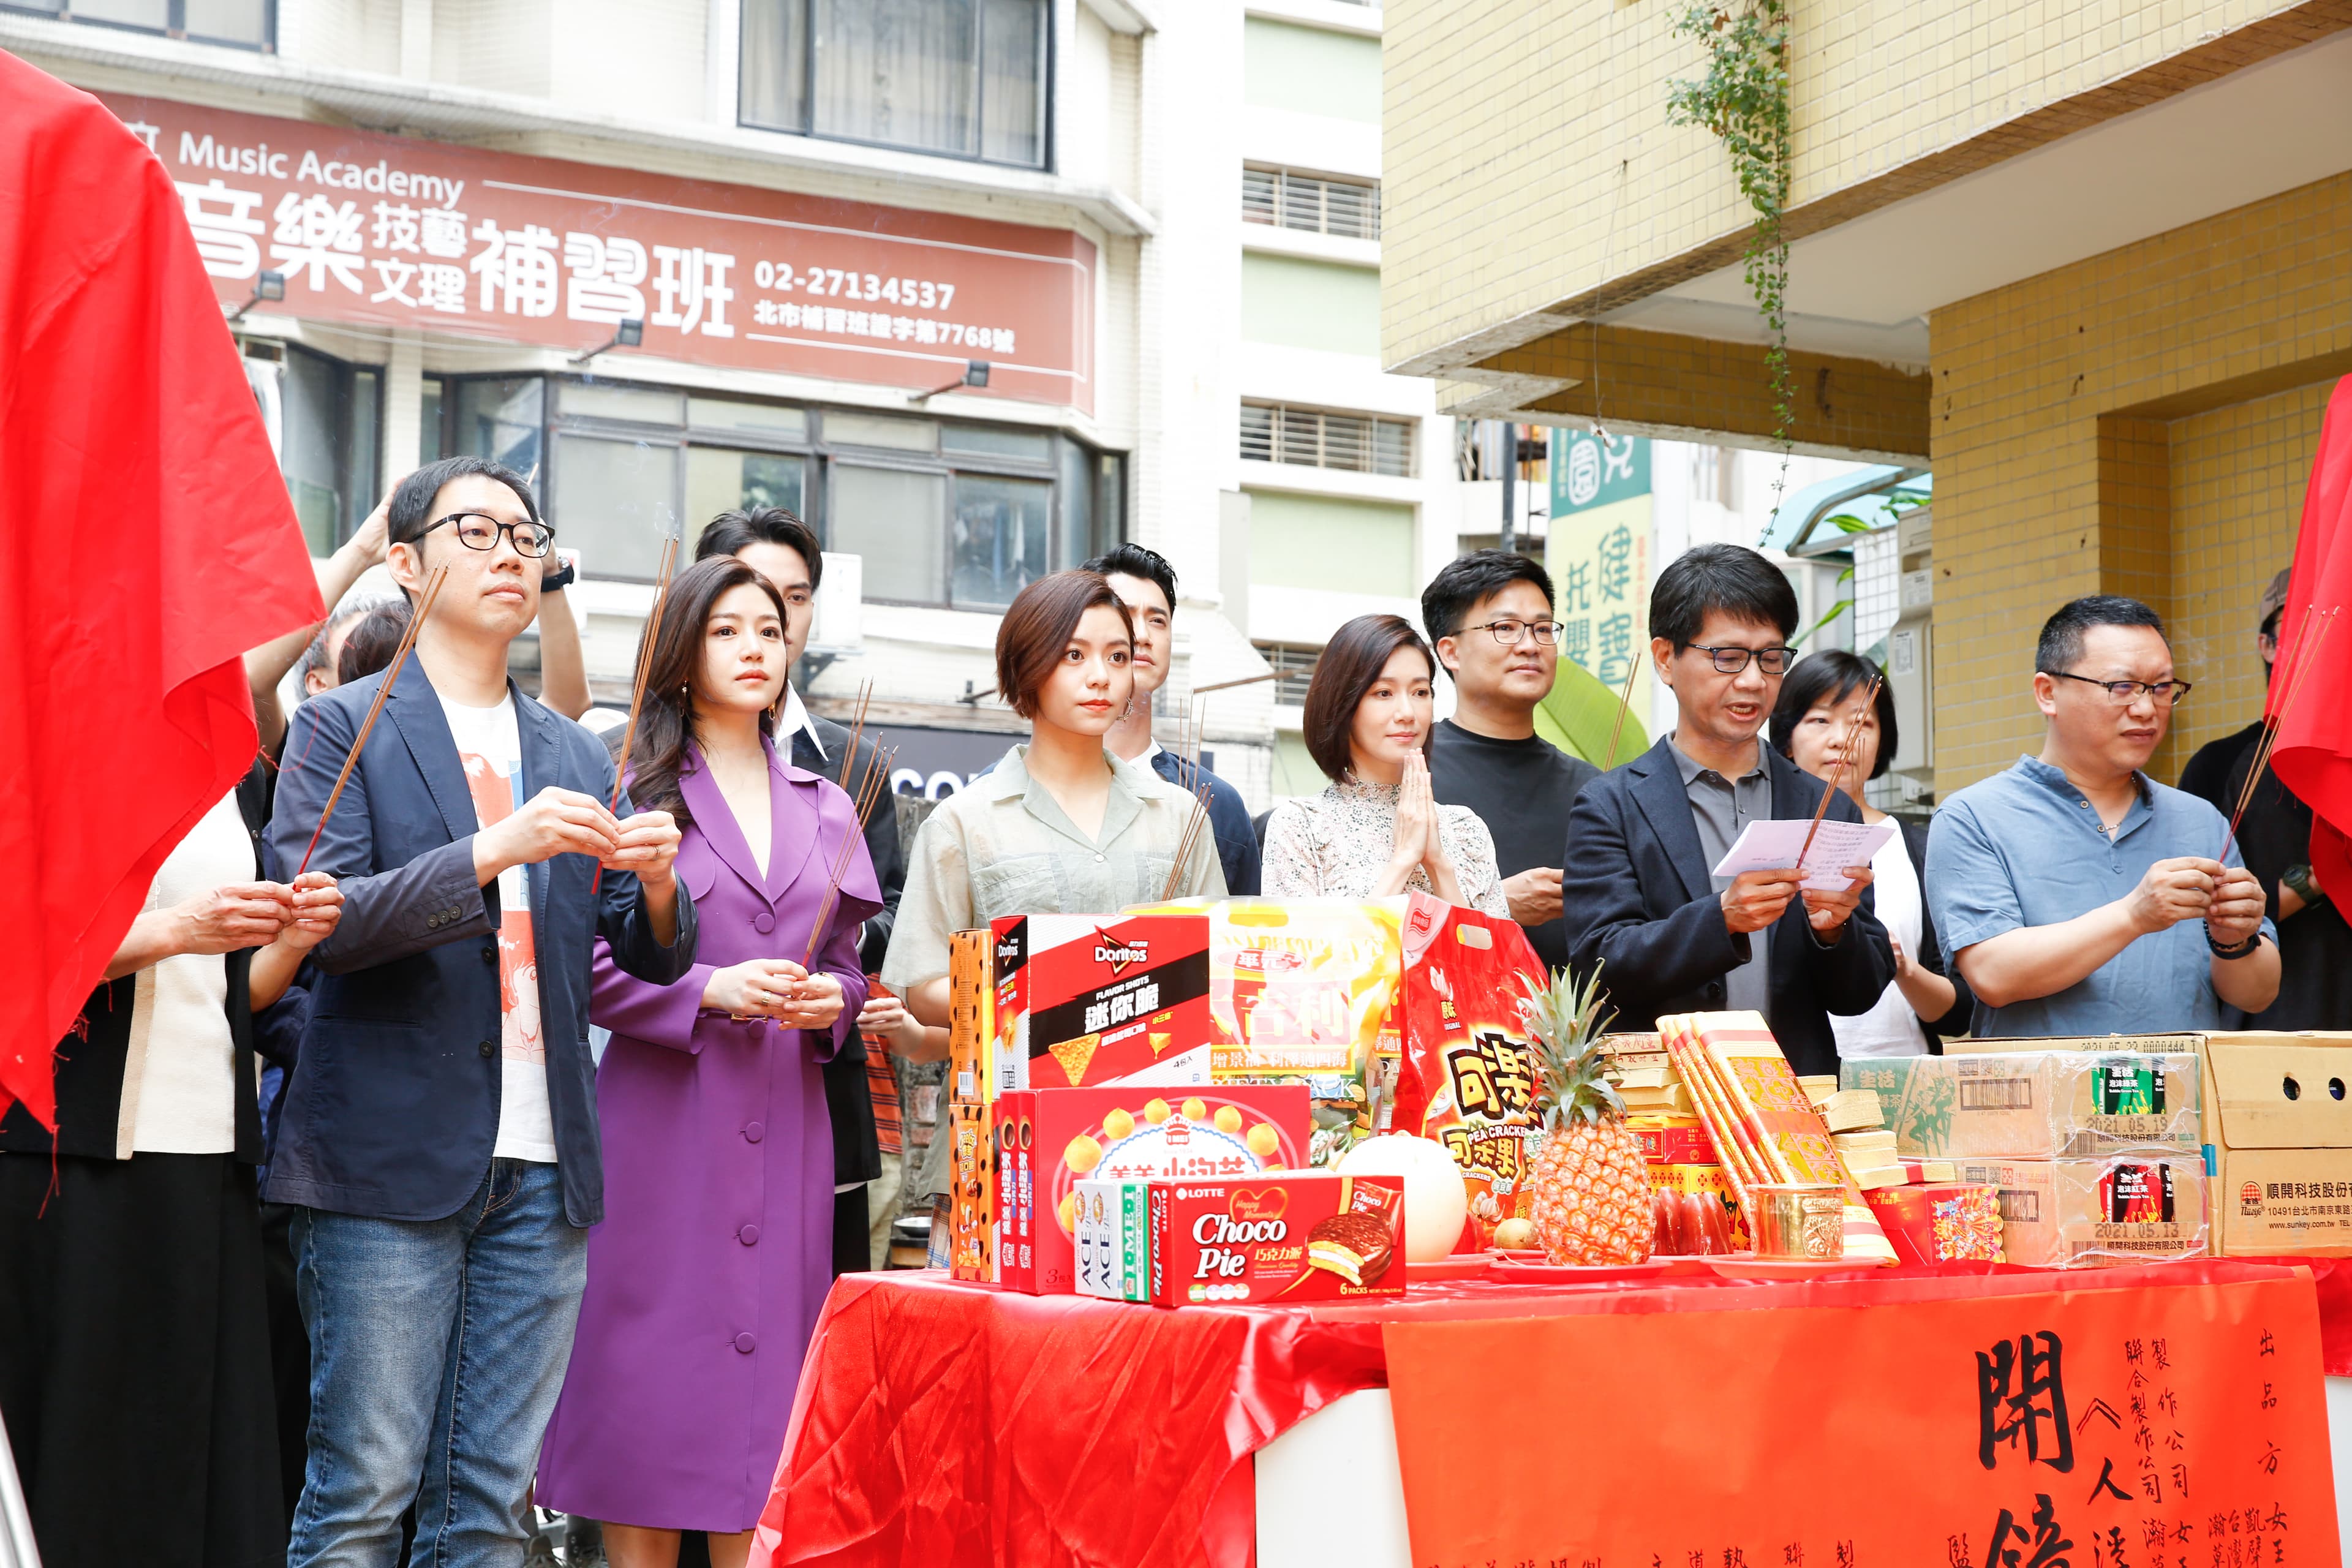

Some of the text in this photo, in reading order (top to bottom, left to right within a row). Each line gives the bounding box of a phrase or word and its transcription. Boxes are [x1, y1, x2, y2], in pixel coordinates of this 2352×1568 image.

[179, 130, 288, 179] Music
[296, 149, 465, 209] Academy
[371, 200, 467, 259] 技藝
[174, 178, 735, 339] 音樂 補習班
[371, 258, 467, 314] 文理
[754, 260, 955, 311] 02-27134537
[998, 945, 1018, 957] Doritos
[1094, 946, 1148, 962] Doritos
[1096, 975, 1150, 1001] FLAVOR SHOTS
[1085, 983, 1159, 1034] 迷你脆
[1441, 1000, 1458, 1020] 原味
[2086, 1117, 2168, 1133] 2021.05.19
[1467, 1130, 1488, 1146] PEA
[2097, 1133, 2176, 1142] 順開科技股份有限公司
[1462, 1171, 1491, 1183] CRACKERS
[1188, 1188, 1225, 1198] LOTTE
[1353, 1190, 1382, 1207] Choco
[1235, 1200, 1260, 1212] Happy
[1351, 1200, 1368, 1213] Pie
[2267, 1205, 2352, 1216] 10491台北市南京東路
[1243, 1210, 1275, 1219] Moments
[1192, 1213, 1287, 1245] Choco
[2095, 1223, 2179, 1238] 2021.05.13
[2269, 1220, 2335, 1230] www.sunkey.com.tw
[1152, 1189, 1163, 1297] Choco Pie
[2107, 1241, 2184, 1251] 順開科技股份有限公司
[1081, 1231, 1091, 1287] ACE
[1099, 1233, 1110, 1291] ACE
[1254, 1246, 1303, 1262] 巧克力派
[1193, 1248, 1246, 1278] Pie
[1340, 1283, 1348, 1295] 6
[2257, 1328, 2282, 1475] 出品方
[2151, 1338, 2188, 1499] 製作公司
